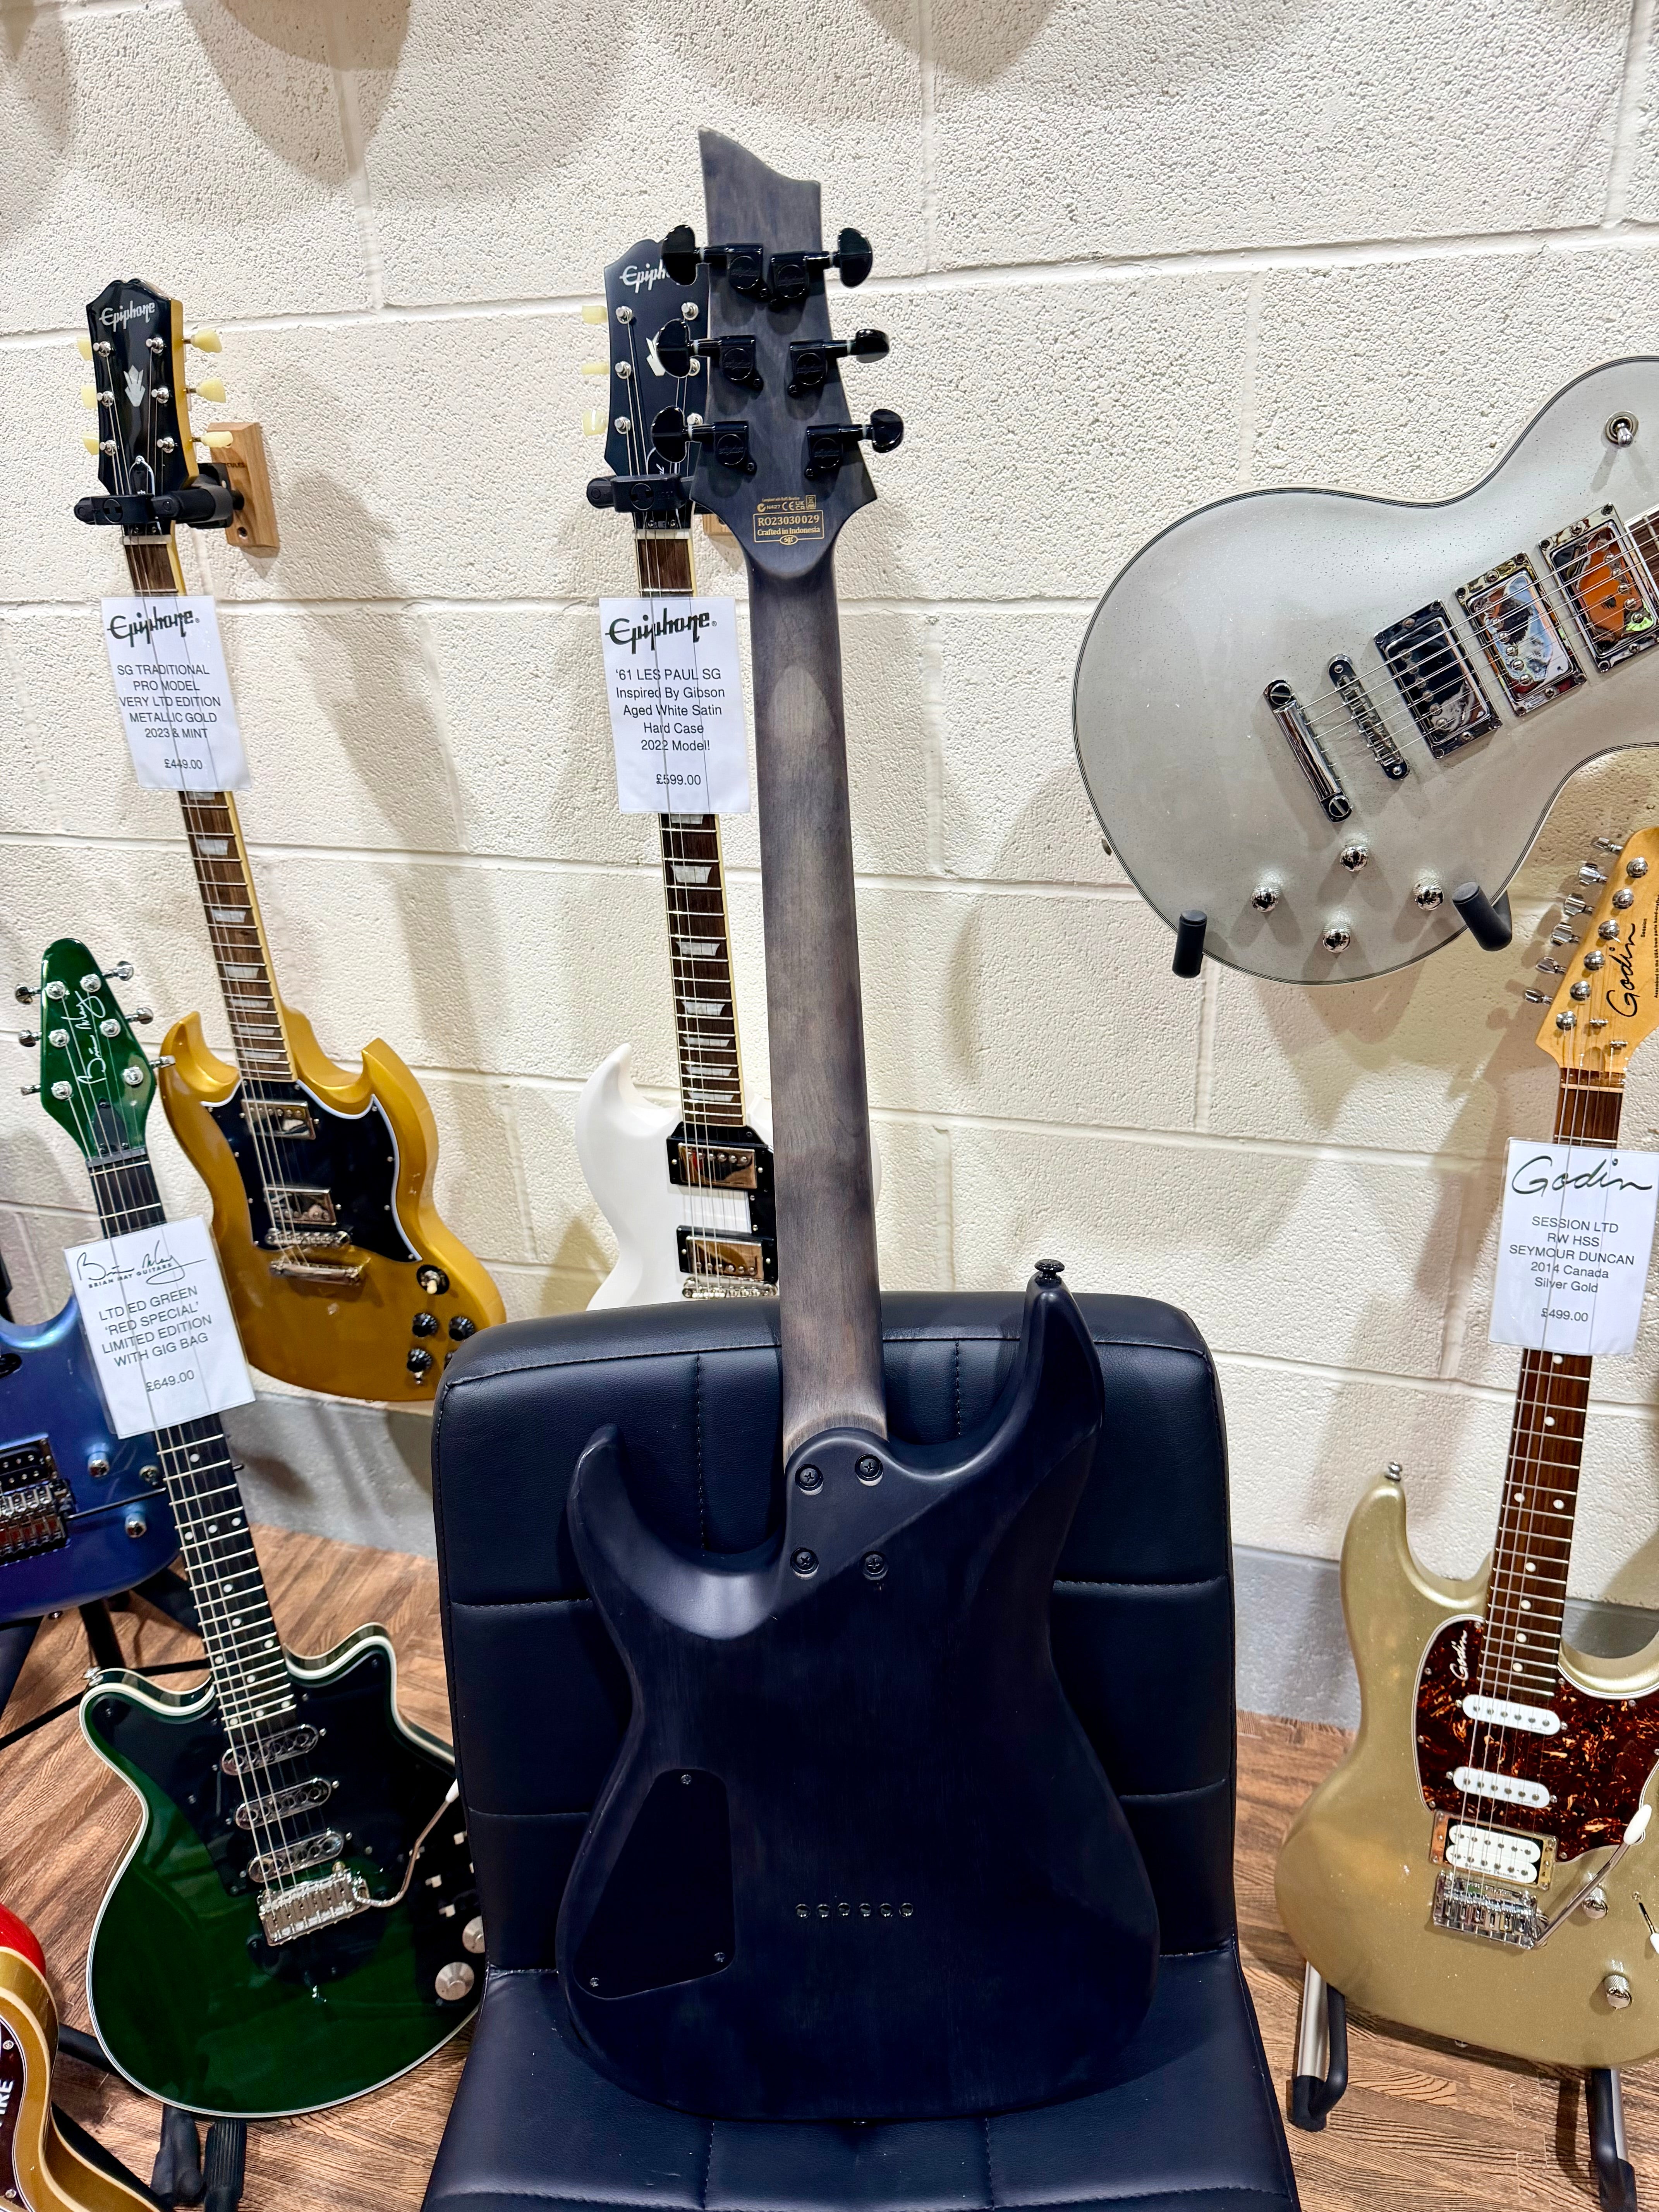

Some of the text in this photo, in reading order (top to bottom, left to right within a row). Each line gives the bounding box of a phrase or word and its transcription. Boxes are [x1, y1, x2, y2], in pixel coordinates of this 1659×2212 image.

[619, 259, 670, 293] Epiph
[99, 301, 155, 332] Epiphone
[757, 528, 781, 536] Crafted
[107, 606, 194, 647] Epiphone
[605, 608, 710, 654] Epiphone
[117, 664, 210, 675] SG TRADITIONAL
[637, 669, 661, 680] LES
[665, 668, 698, 680] PAUL
[702, 668, 721, 680] SG
[133, 680, 200, 691] PRO MODEL
[616, 687, 725, 701] Inspired By Gibson
[119, 697, 221, 707] VERY LTD EDITION
[129, 713, 217, 723] METALLIC GOLD
[623, 704, 722, 718] Aged White Satin
[145, 728, 208, 738] 2023 & MINT
[644, 723, 704, 733] Hard Case
[641, 740, 710, 751] 2022 Model!
[165, 759, 203, 769] £449.00
[656, 774, 701, 785] £599.00
[1606, 923, 1640, 1018] Godin
[1512, 1155, 1653, 1197] Godin
[1532, 1216, 1618, 1233] SESSION LTD
[1547, 1233, 1600, 1247] RW HSS
[1509, 1244, 1634, 1266] SEYMOUR DUNCAN
[88, 1263, 173, 1288] BRIAN MAY GUITARS
[1531, 1261, 1609, 1278] 2014 Canada
[1534, 1276, 1598, 1293] Silver Gold
[98, 1285, 198, 1321] LTD ED GREEN
[1541, 1308, 1588, 1322] £499.00
[101, 1314, 213, 1354] LIMITED EDITION
[113, 1332, 209, 1367] WITH GIG BAG
[146, 1369, 195, 1393] £649.00
[1449, 1629, 1469, 1681] Godin
